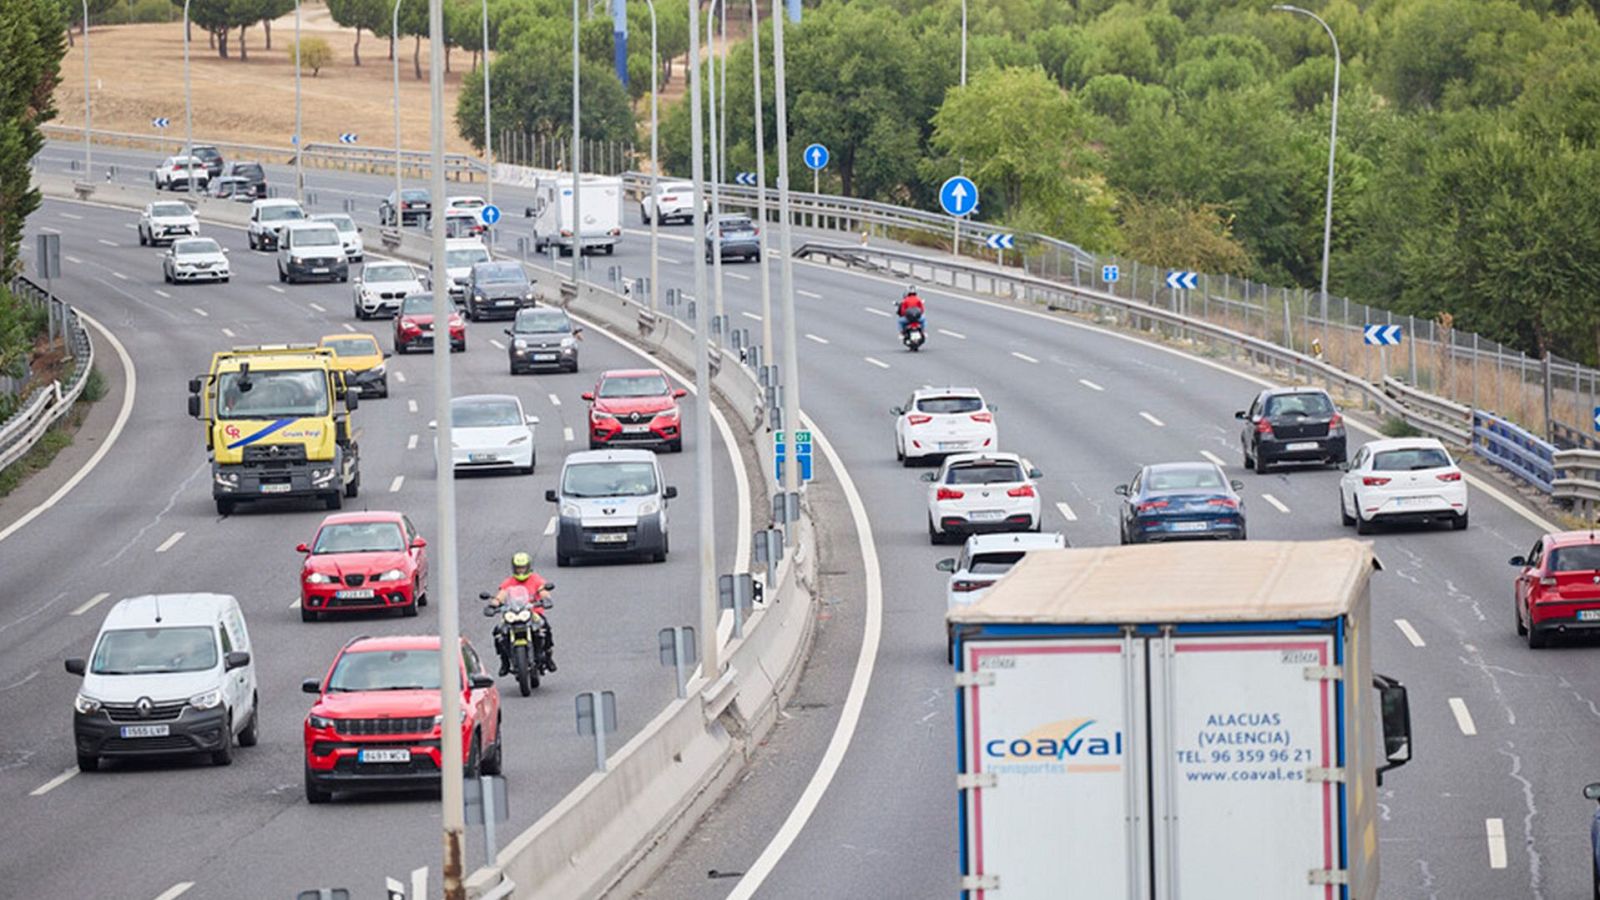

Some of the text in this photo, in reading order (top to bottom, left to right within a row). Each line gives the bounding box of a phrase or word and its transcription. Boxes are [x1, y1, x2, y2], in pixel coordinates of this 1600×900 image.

[1207, 713, 1281, 726] ALACUAS
[986, 730, 1122, 760] coaval
[1198, 731, 1290, 747] (VALENCIA)
[1176, 749, 1312, 763] TEL. 96 359 96 21
[987, 763, 1065, 775] transportes
[1187, 767, 1303, 781] www.coaval.es
